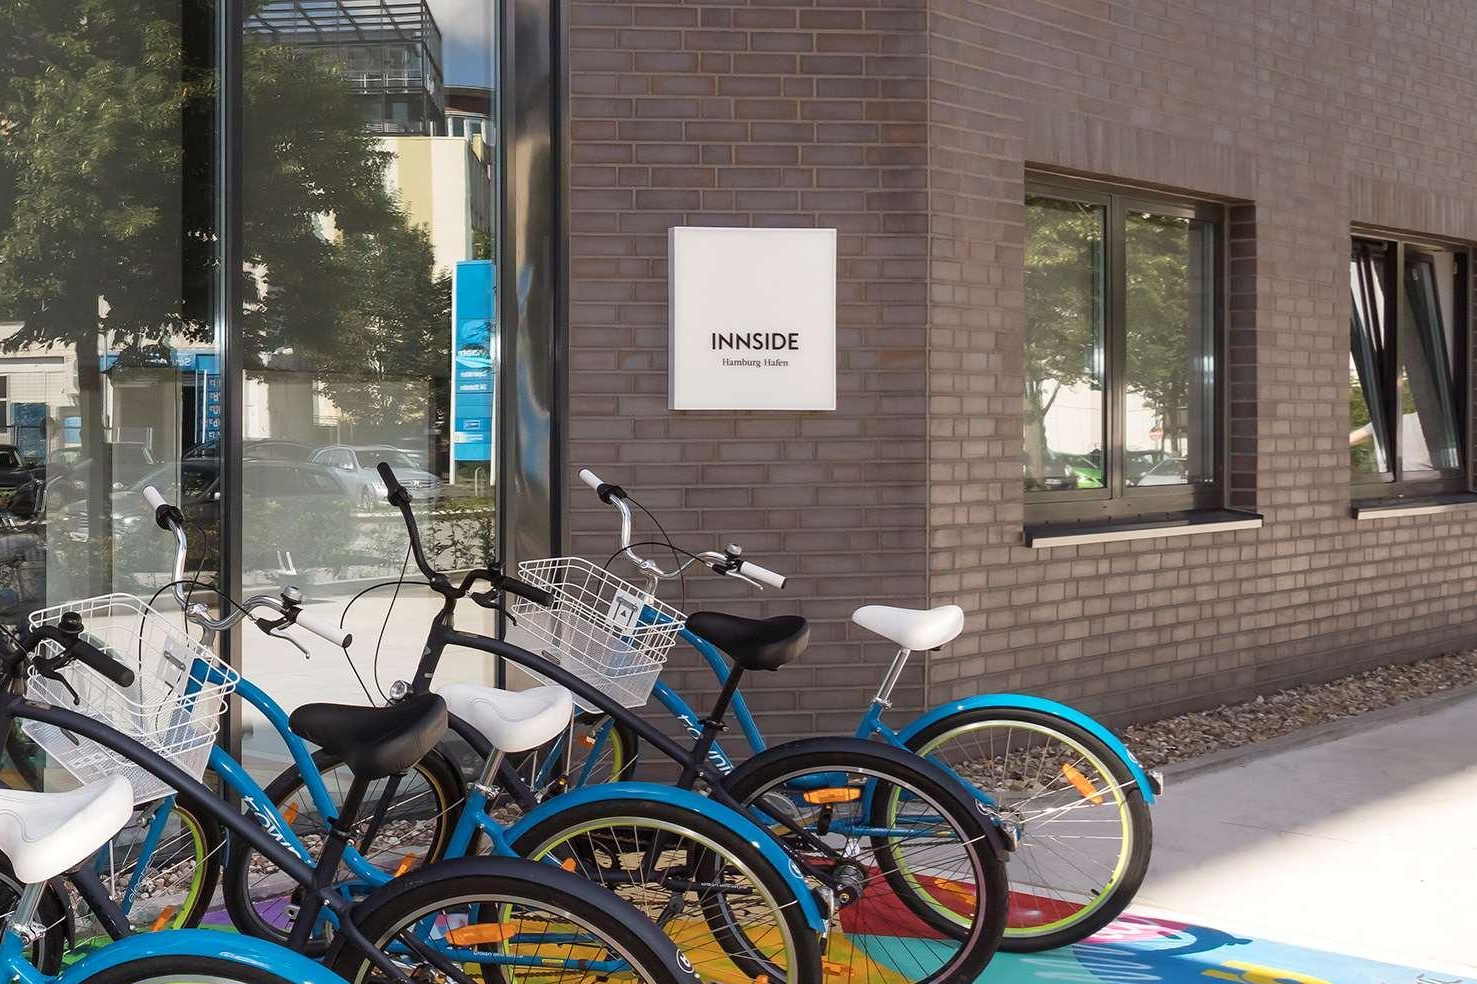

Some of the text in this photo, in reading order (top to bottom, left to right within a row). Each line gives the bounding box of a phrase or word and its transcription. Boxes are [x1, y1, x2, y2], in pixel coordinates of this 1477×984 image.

[712, 332, 799, 350] INNSIDE
[722, 358, 789, 369] Hamburg Hafen
